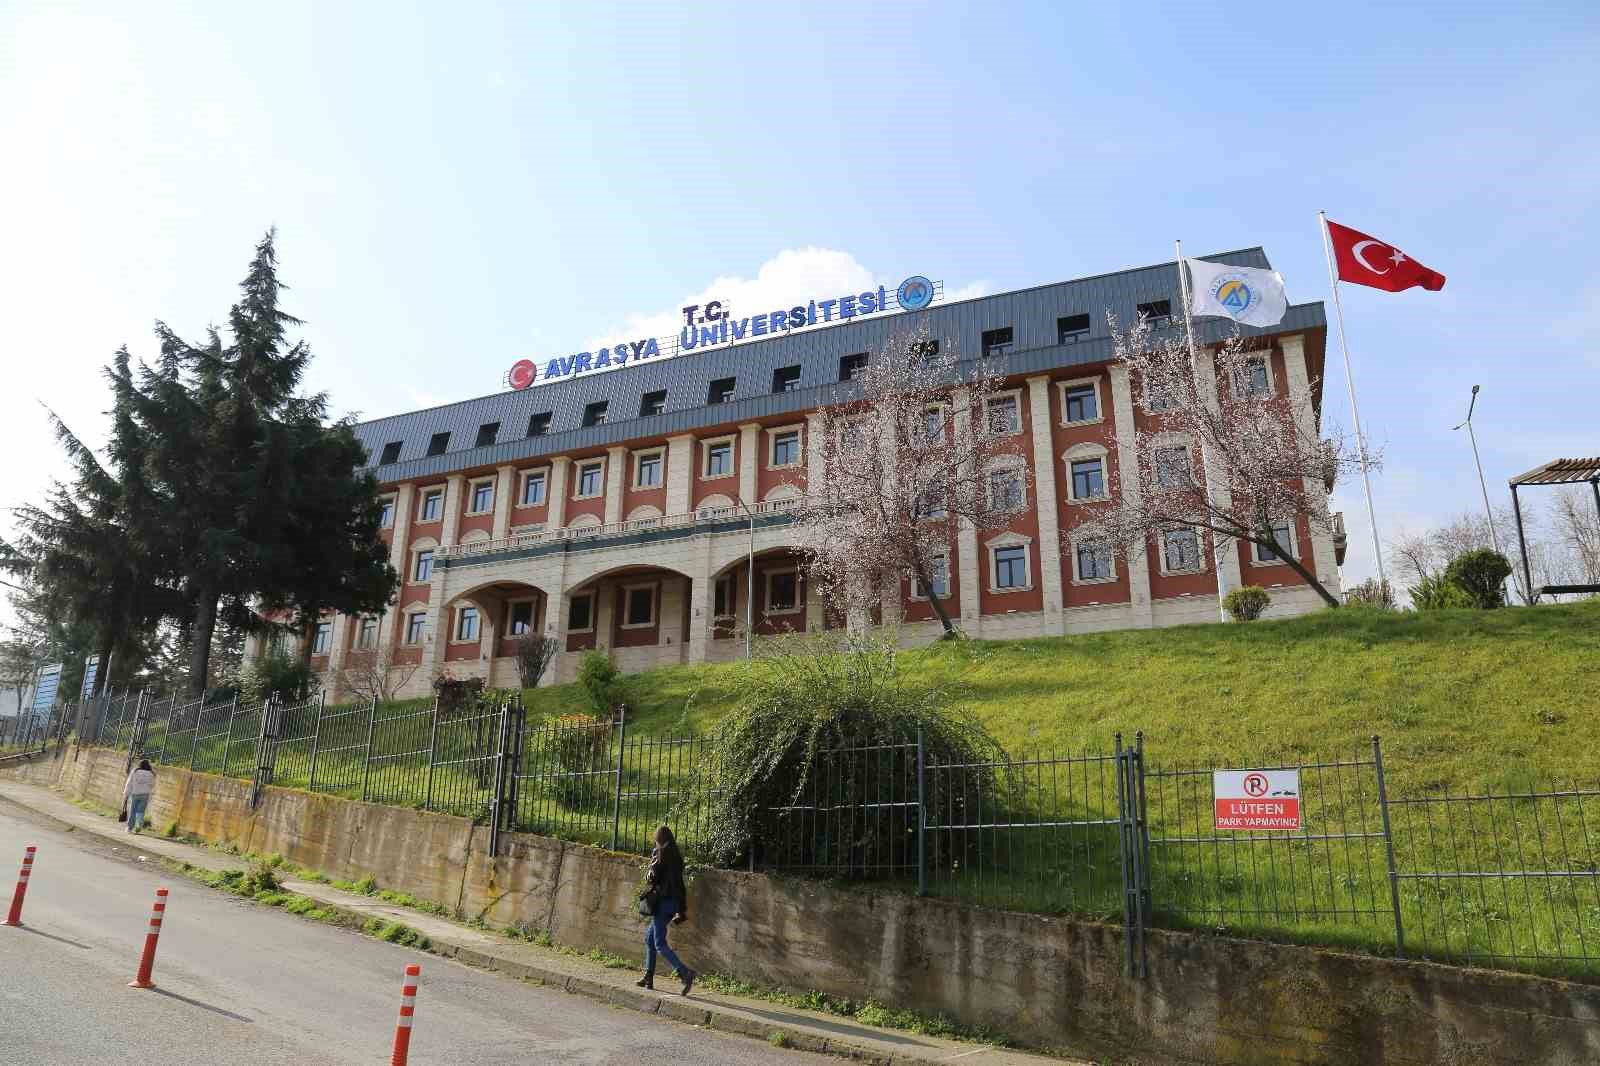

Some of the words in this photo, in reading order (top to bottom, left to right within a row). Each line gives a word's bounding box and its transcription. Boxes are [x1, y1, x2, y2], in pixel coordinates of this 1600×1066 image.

[682, 300, 730, 326] T.C.
[544, 338, 660, 379] AVRASYA
[1231, 800, 1284, 815] LÜTFEN
[1218, 817, 1241, 826] PARK
[1245, 817, 1297, 827] YAPMAYINIZ
